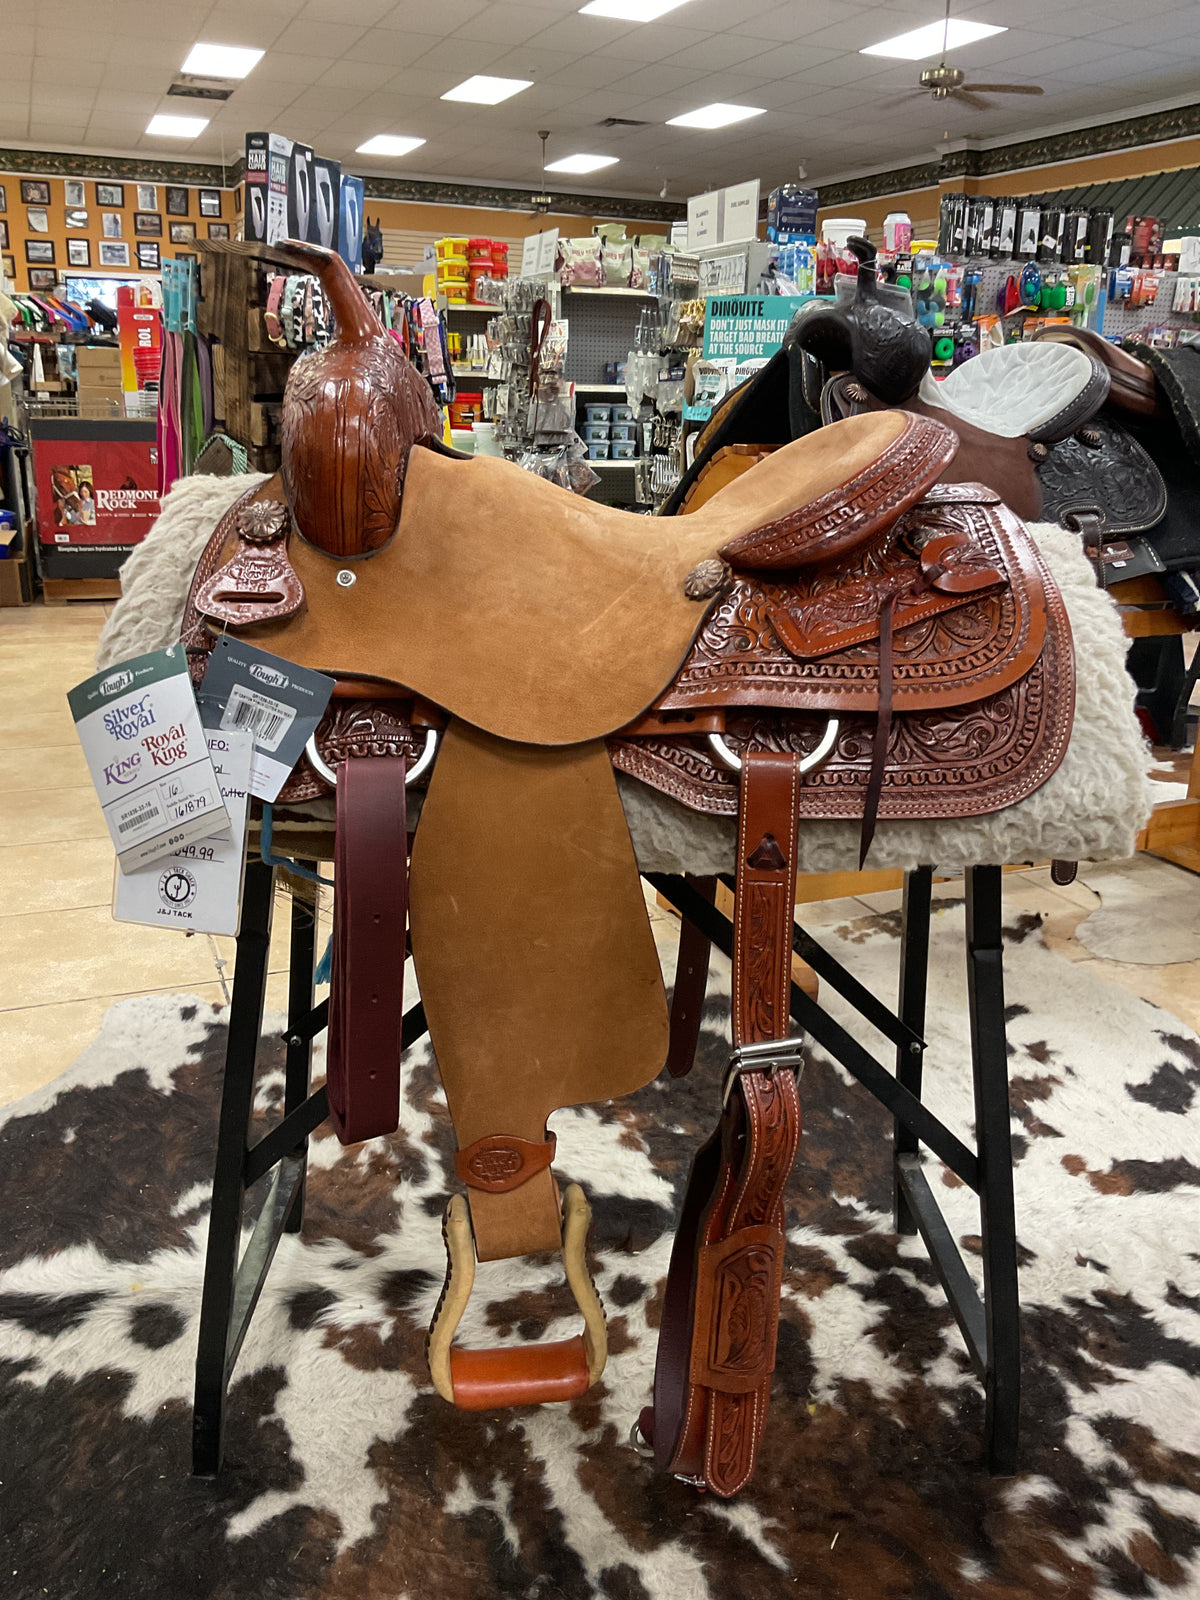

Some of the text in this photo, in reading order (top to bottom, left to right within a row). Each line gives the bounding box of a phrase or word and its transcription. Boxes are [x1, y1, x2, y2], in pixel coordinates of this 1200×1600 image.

[248, 153, 266, 163] HAIR
[272, 161, 286, 175] HAIR
[711, 300, 764, 317] DINOVITE
[710, 319, 788, 330] DON'T JUST MASK IT!
[710, 332, 738, 343] TARGET
[738, 332, 755, 342] BAD
[708, 344, 764, 355] AT THE SOURCE
[226, 656, 247, 668] QUALITY
[291, 683, 314, 696] PRODUCTS
[104, 694, 150, 732] Silver
[110, 708, 156, 740] Royal
[141, 723, 186, 752] Royal
[150, 740, 188, 766] King
[103, 752, 141, 785] KING
[168, 784, 178, 798] 16
[221, 786, 247, 798] Cutter
[174, 796, 206, 819] 161879
[156, 908, 193, 919] J&J TACK
